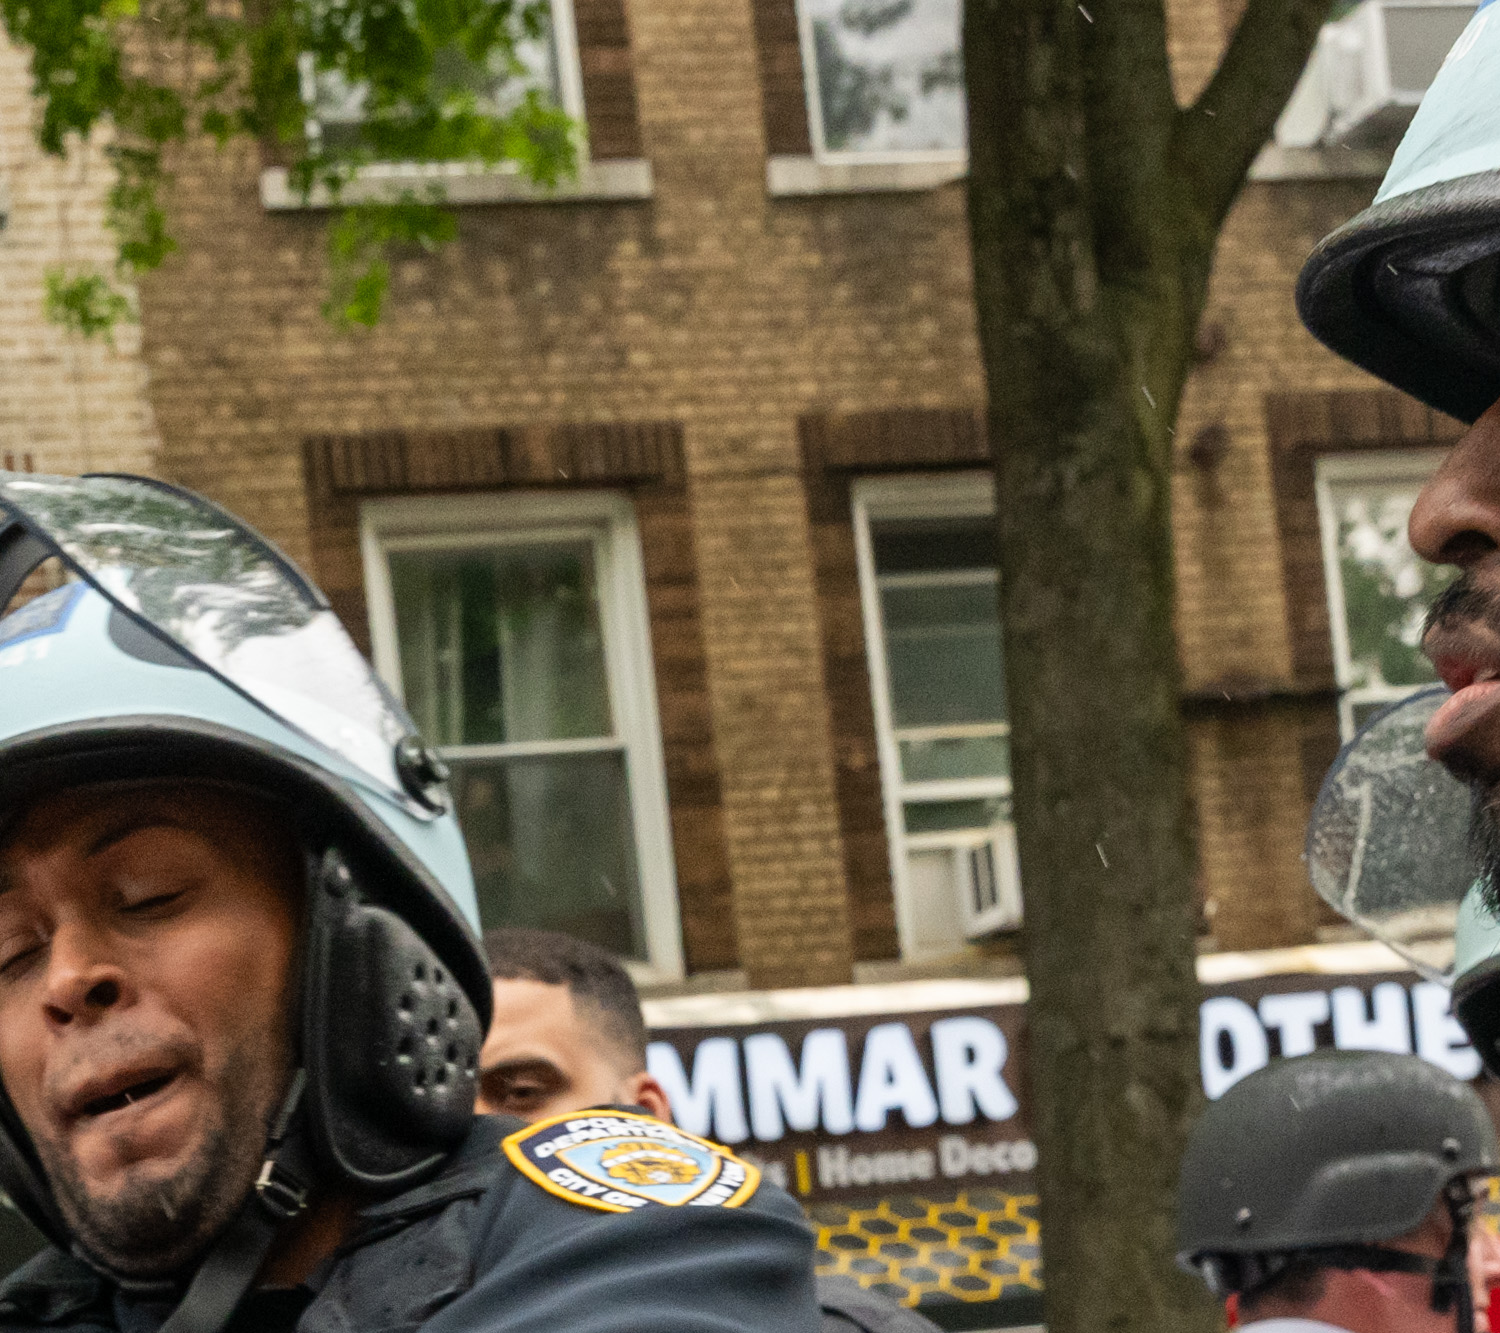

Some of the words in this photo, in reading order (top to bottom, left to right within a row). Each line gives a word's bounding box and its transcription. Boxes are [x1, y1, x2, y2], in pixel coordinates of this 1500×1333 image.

[534, 1126, 709, 1158] DEPART
[817, 1145, 935, 1189] Home
[939, 1134, 1038, 1178] Deco
[547, 1168, 606, 1198] CITY
